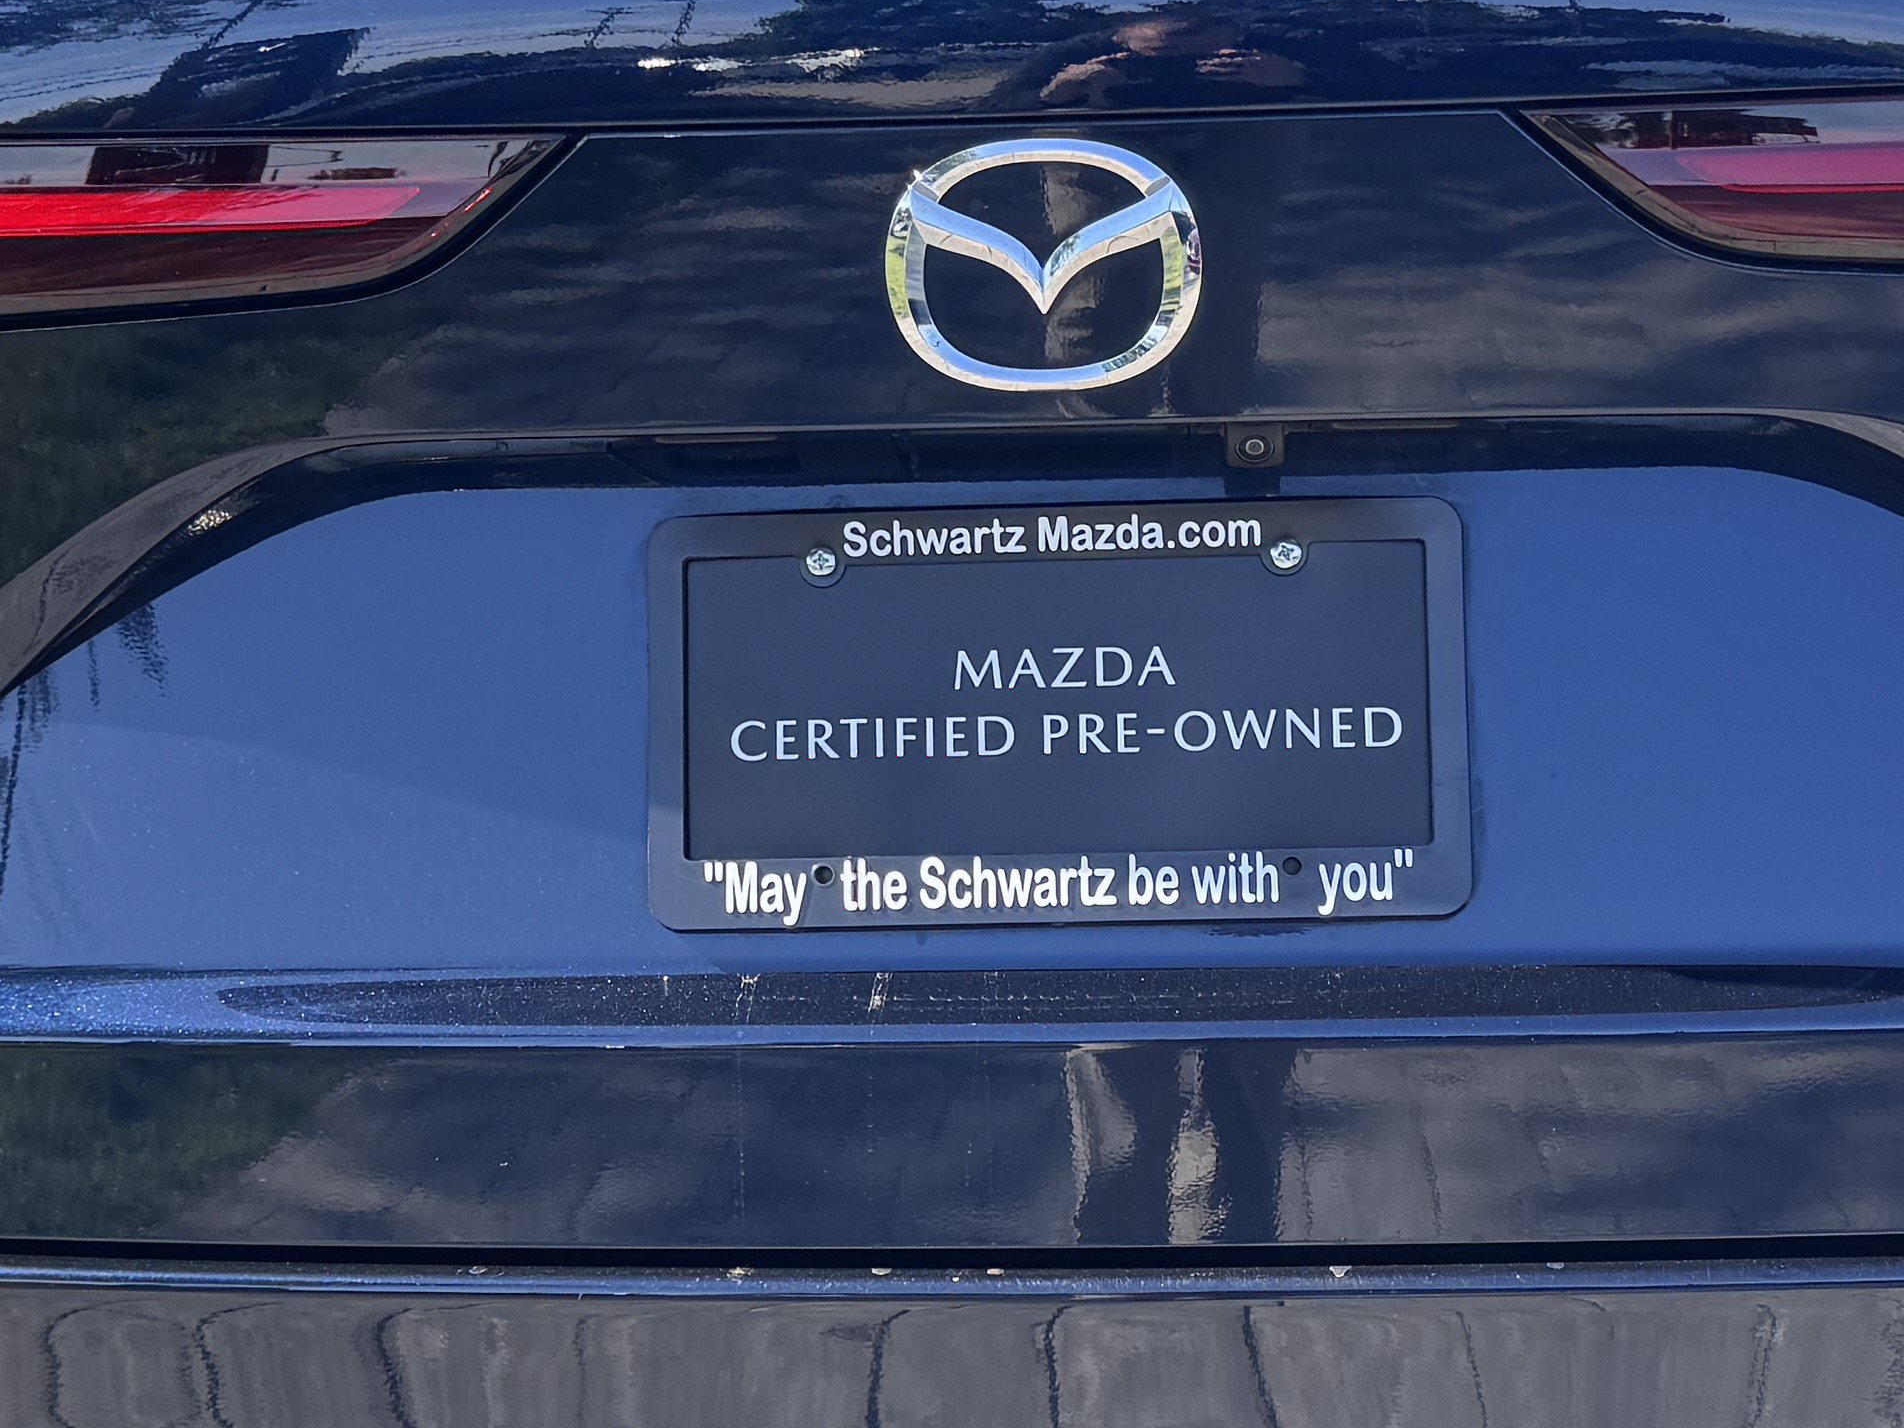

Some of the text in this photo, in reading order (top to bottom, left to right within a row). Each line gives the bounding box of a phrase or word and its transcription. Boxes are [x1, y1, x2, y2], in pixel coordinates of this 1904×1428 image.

[842, 517, 1263, 560] Schwartz Mazda.com
[953, 646, 1176, 692] MAZDA
[730, 707, 1403, 763] CERTIFIED PRE-OWNED
[703, 849, 1414, 925] "May the Schwartz be with you"
